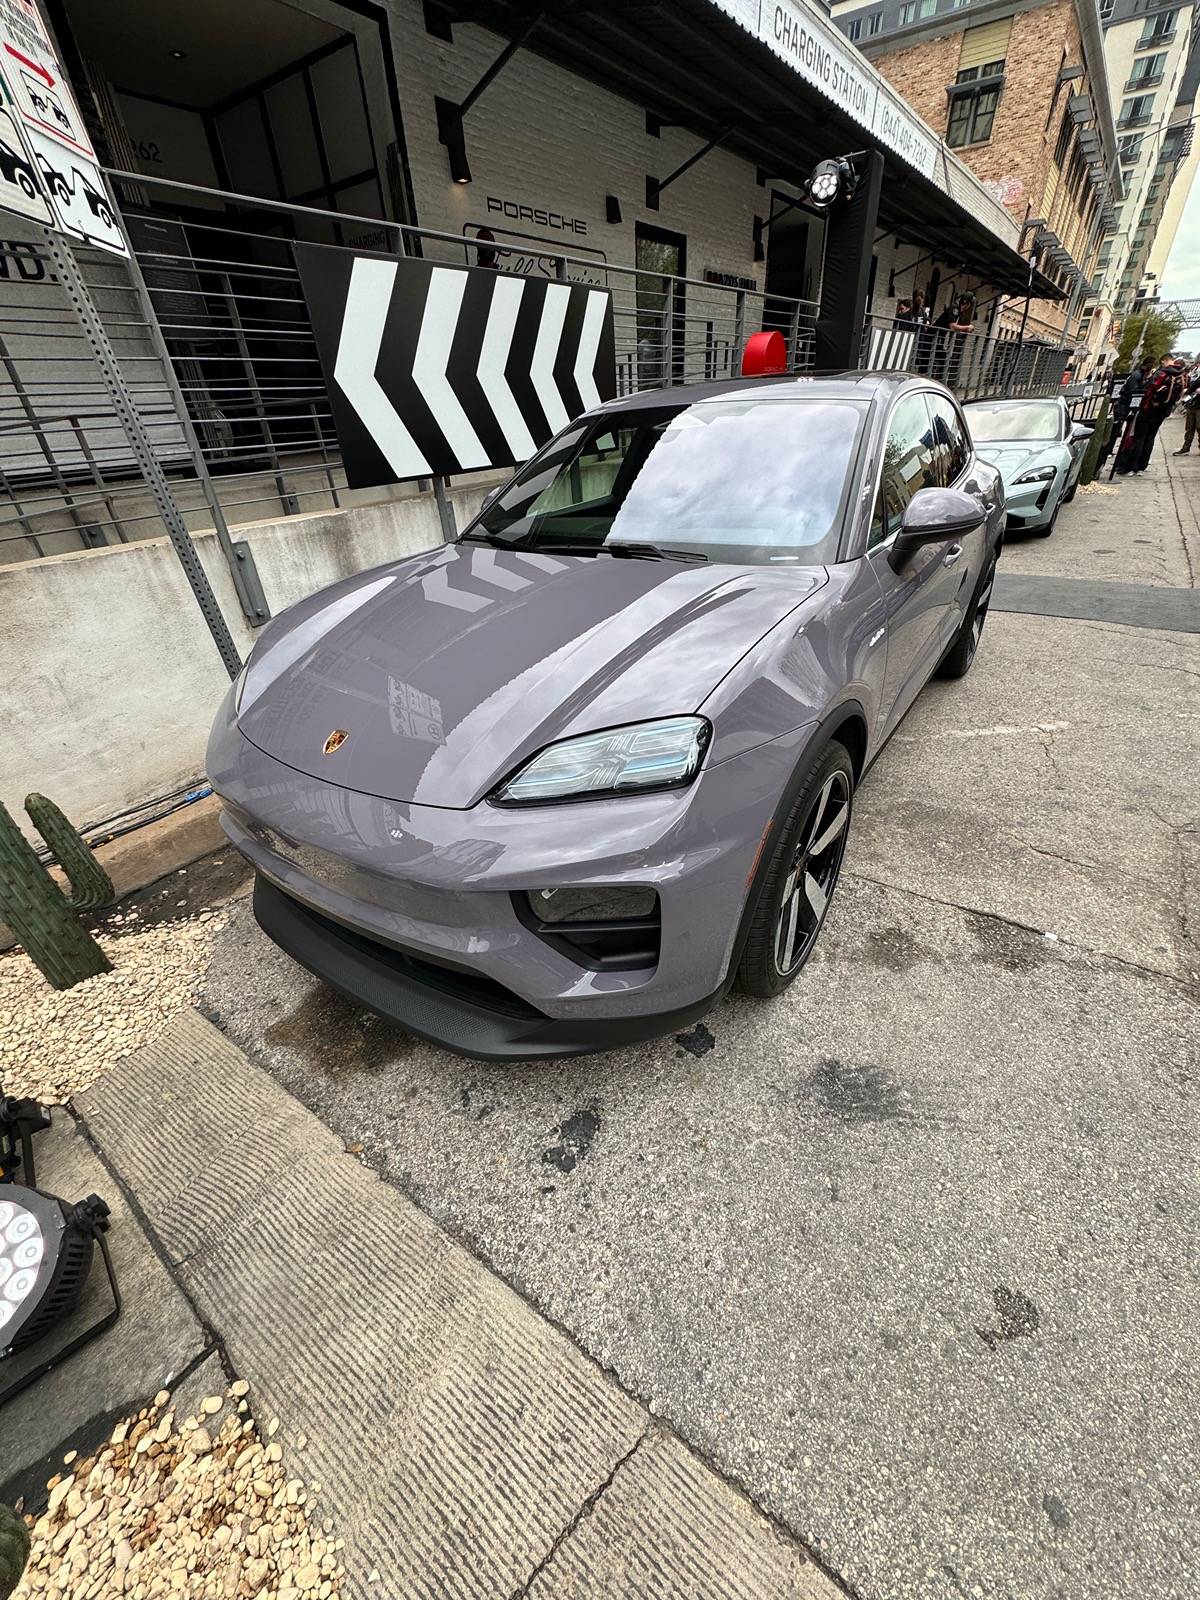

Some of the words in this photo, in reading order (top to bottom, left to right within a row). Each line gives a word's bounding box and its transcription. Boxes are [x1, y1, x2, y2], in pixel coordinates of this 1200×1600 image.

[773, 5, 831, 83] CHARGING
[832, 60, 870, 115] STATION
[487, 196, 587, 236] PORSCHE
